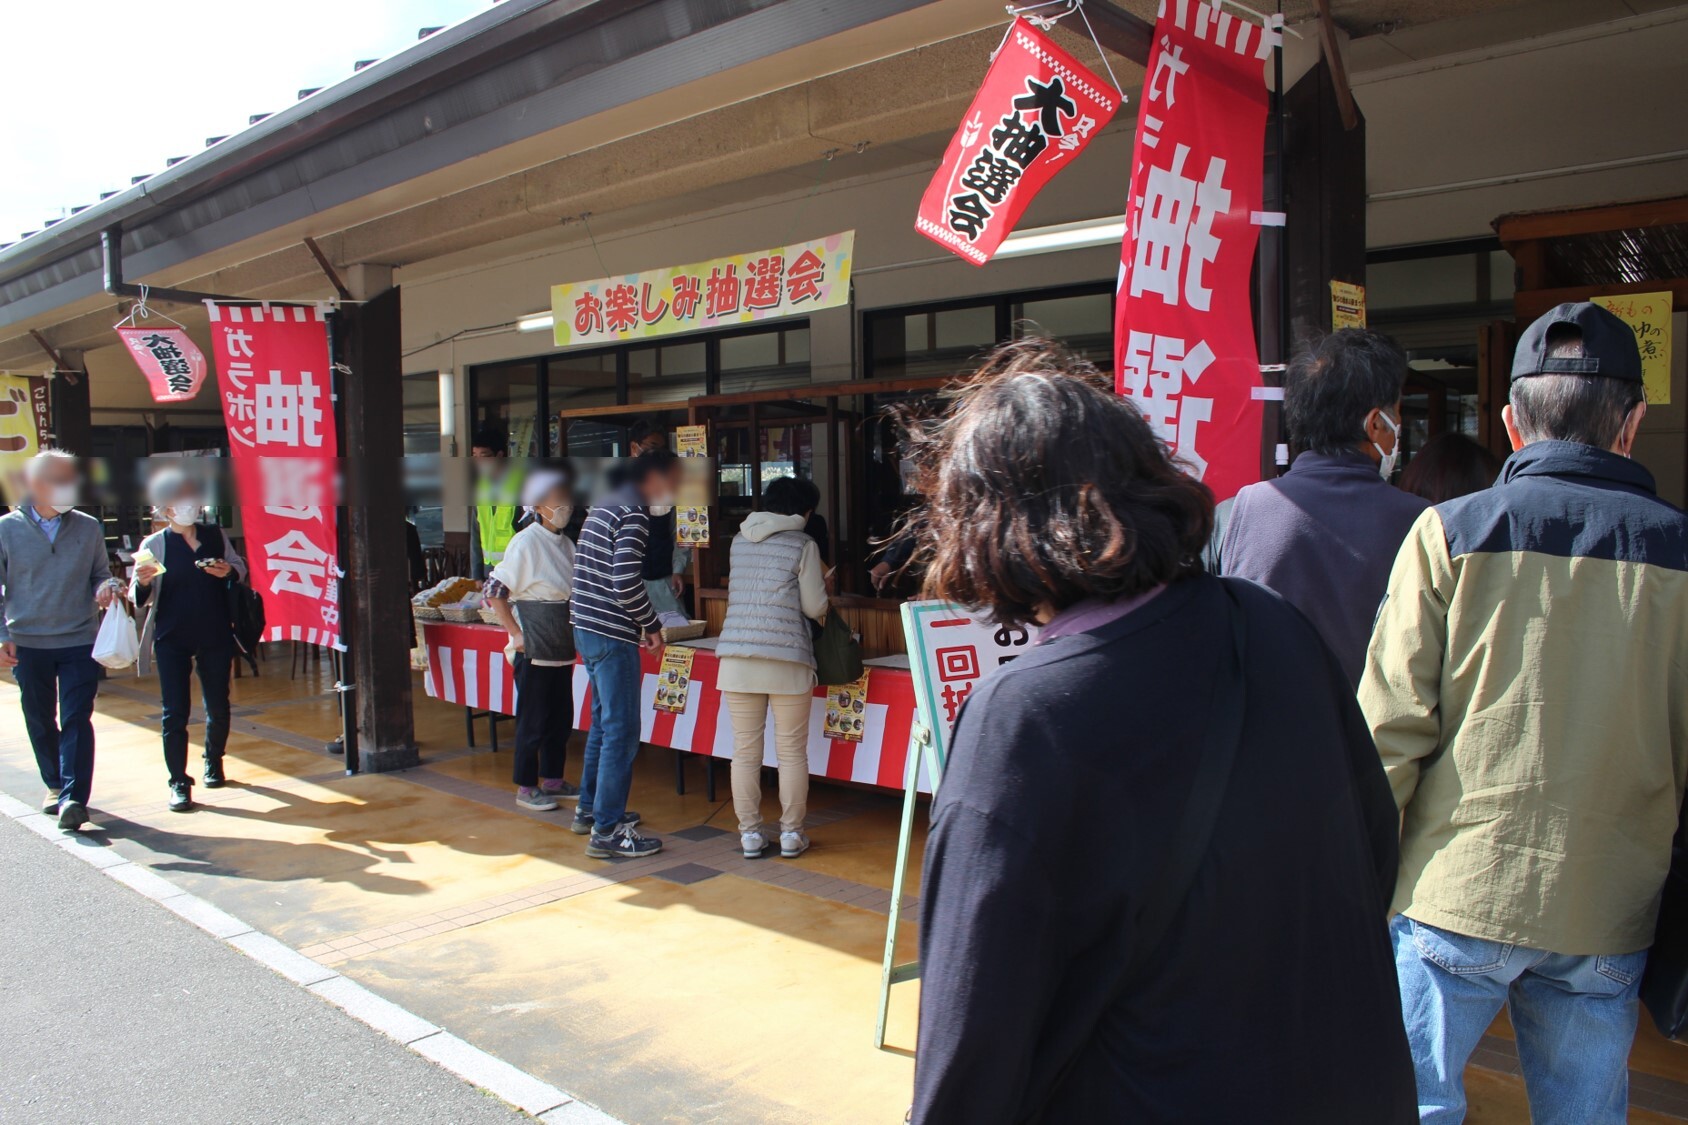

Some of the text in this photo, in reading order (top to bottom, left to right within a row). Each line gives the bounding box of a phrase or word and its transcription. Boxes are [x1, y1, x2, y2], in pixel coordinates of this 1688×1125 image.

[948, 76, 1075, 241] 大抽選会
[573, 249, 826, 335] お楽しみ抽選会
